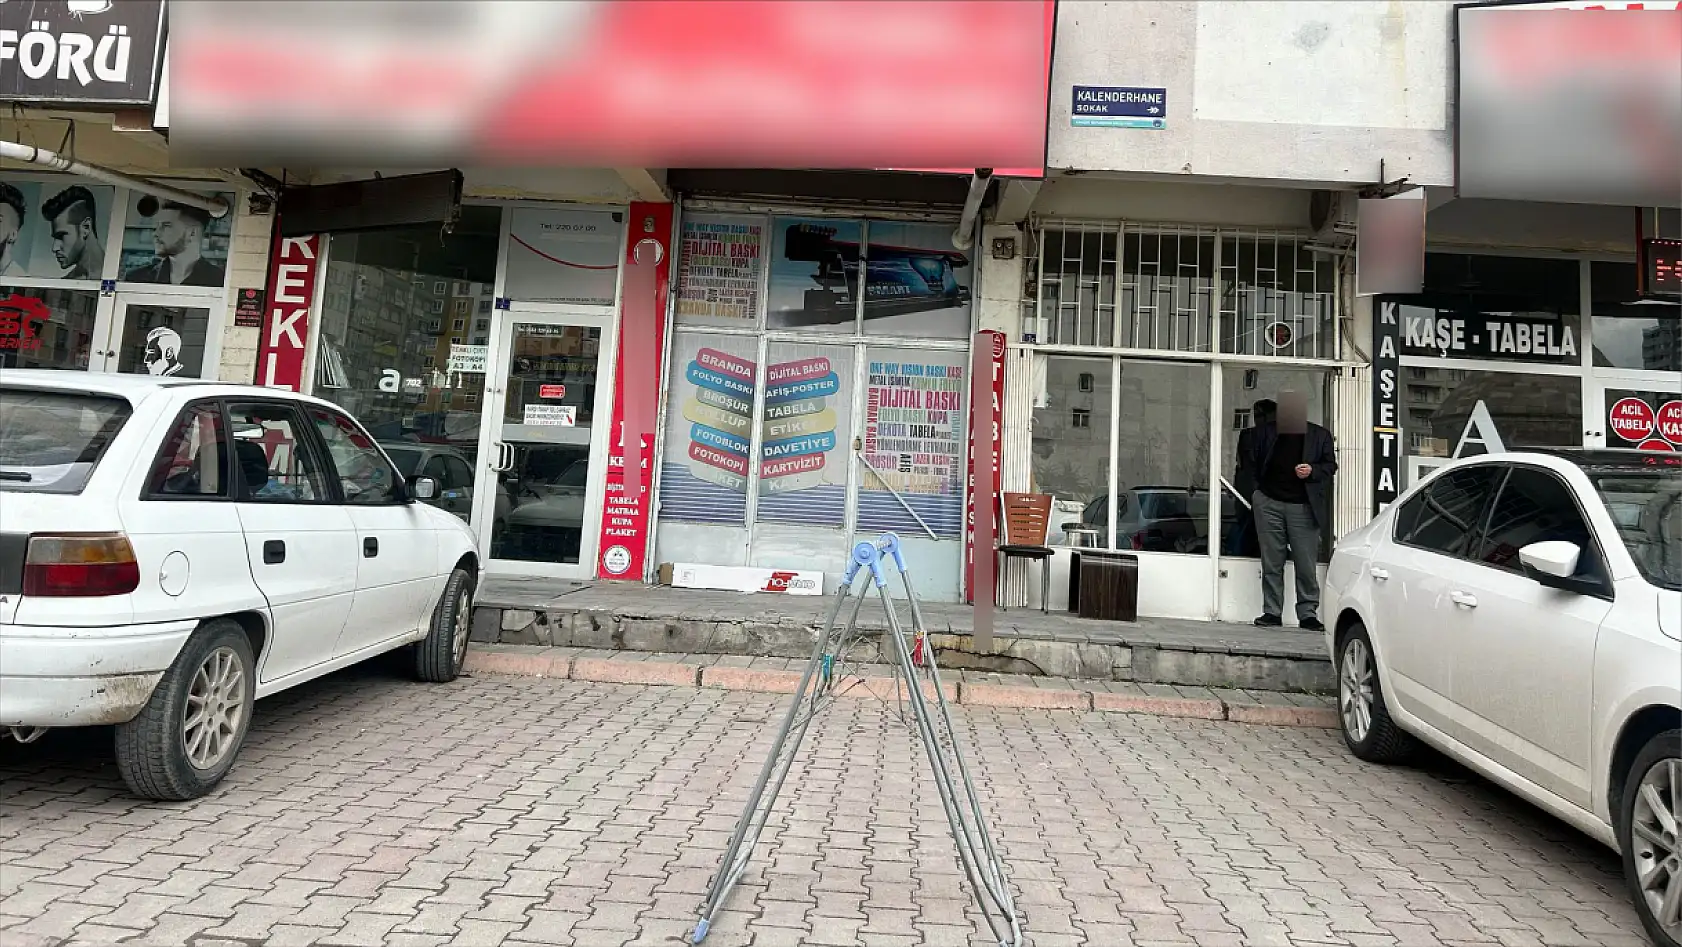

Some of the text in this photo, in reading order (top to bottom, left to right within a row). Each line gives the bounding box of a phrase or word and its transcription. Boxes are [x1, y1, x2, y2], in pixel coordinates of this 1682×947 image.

[1077, 90, 1163, 103] KALENDERHANE
[1077, 104, 1108, 112] SOKAK
[1405, 317, 1465, 358] KAŞE
[1486, 322, 1577, 356] TABELA
[701, 353, 751, 377] BRANDA
[769, 362, 828, 381] DİJİTAL BASKI
[693, 369, 754, 395] FOLYO BASKI
[766, 380, 834, 398] AFİŞ-POSTER
[703, 390, 749, 414] BROŞÜR
[880, 386, 961, 410] DİJİTAL BASKI
[767, 402, 816, 418] TABELA
[1621, 403, 1644, 416] ACİL
[910, 424, 935, 439] TABELA
[1612, 417, 1652, 431] TABELA
[696, 428, 749, 454] FOTOBLOK
[764, 437, 831, 456] DAVETİYE
[694, 446, 744, 471] FOTOKOPİ
[763, 456, 822, 475] KARTVİZİT
[609, 497, 639, 506] TABELA
[606, 507, 640, 516] MATBAA
[611, 517, 633, 526] KUPA
[605, 528, 637, 537] PLAKET
